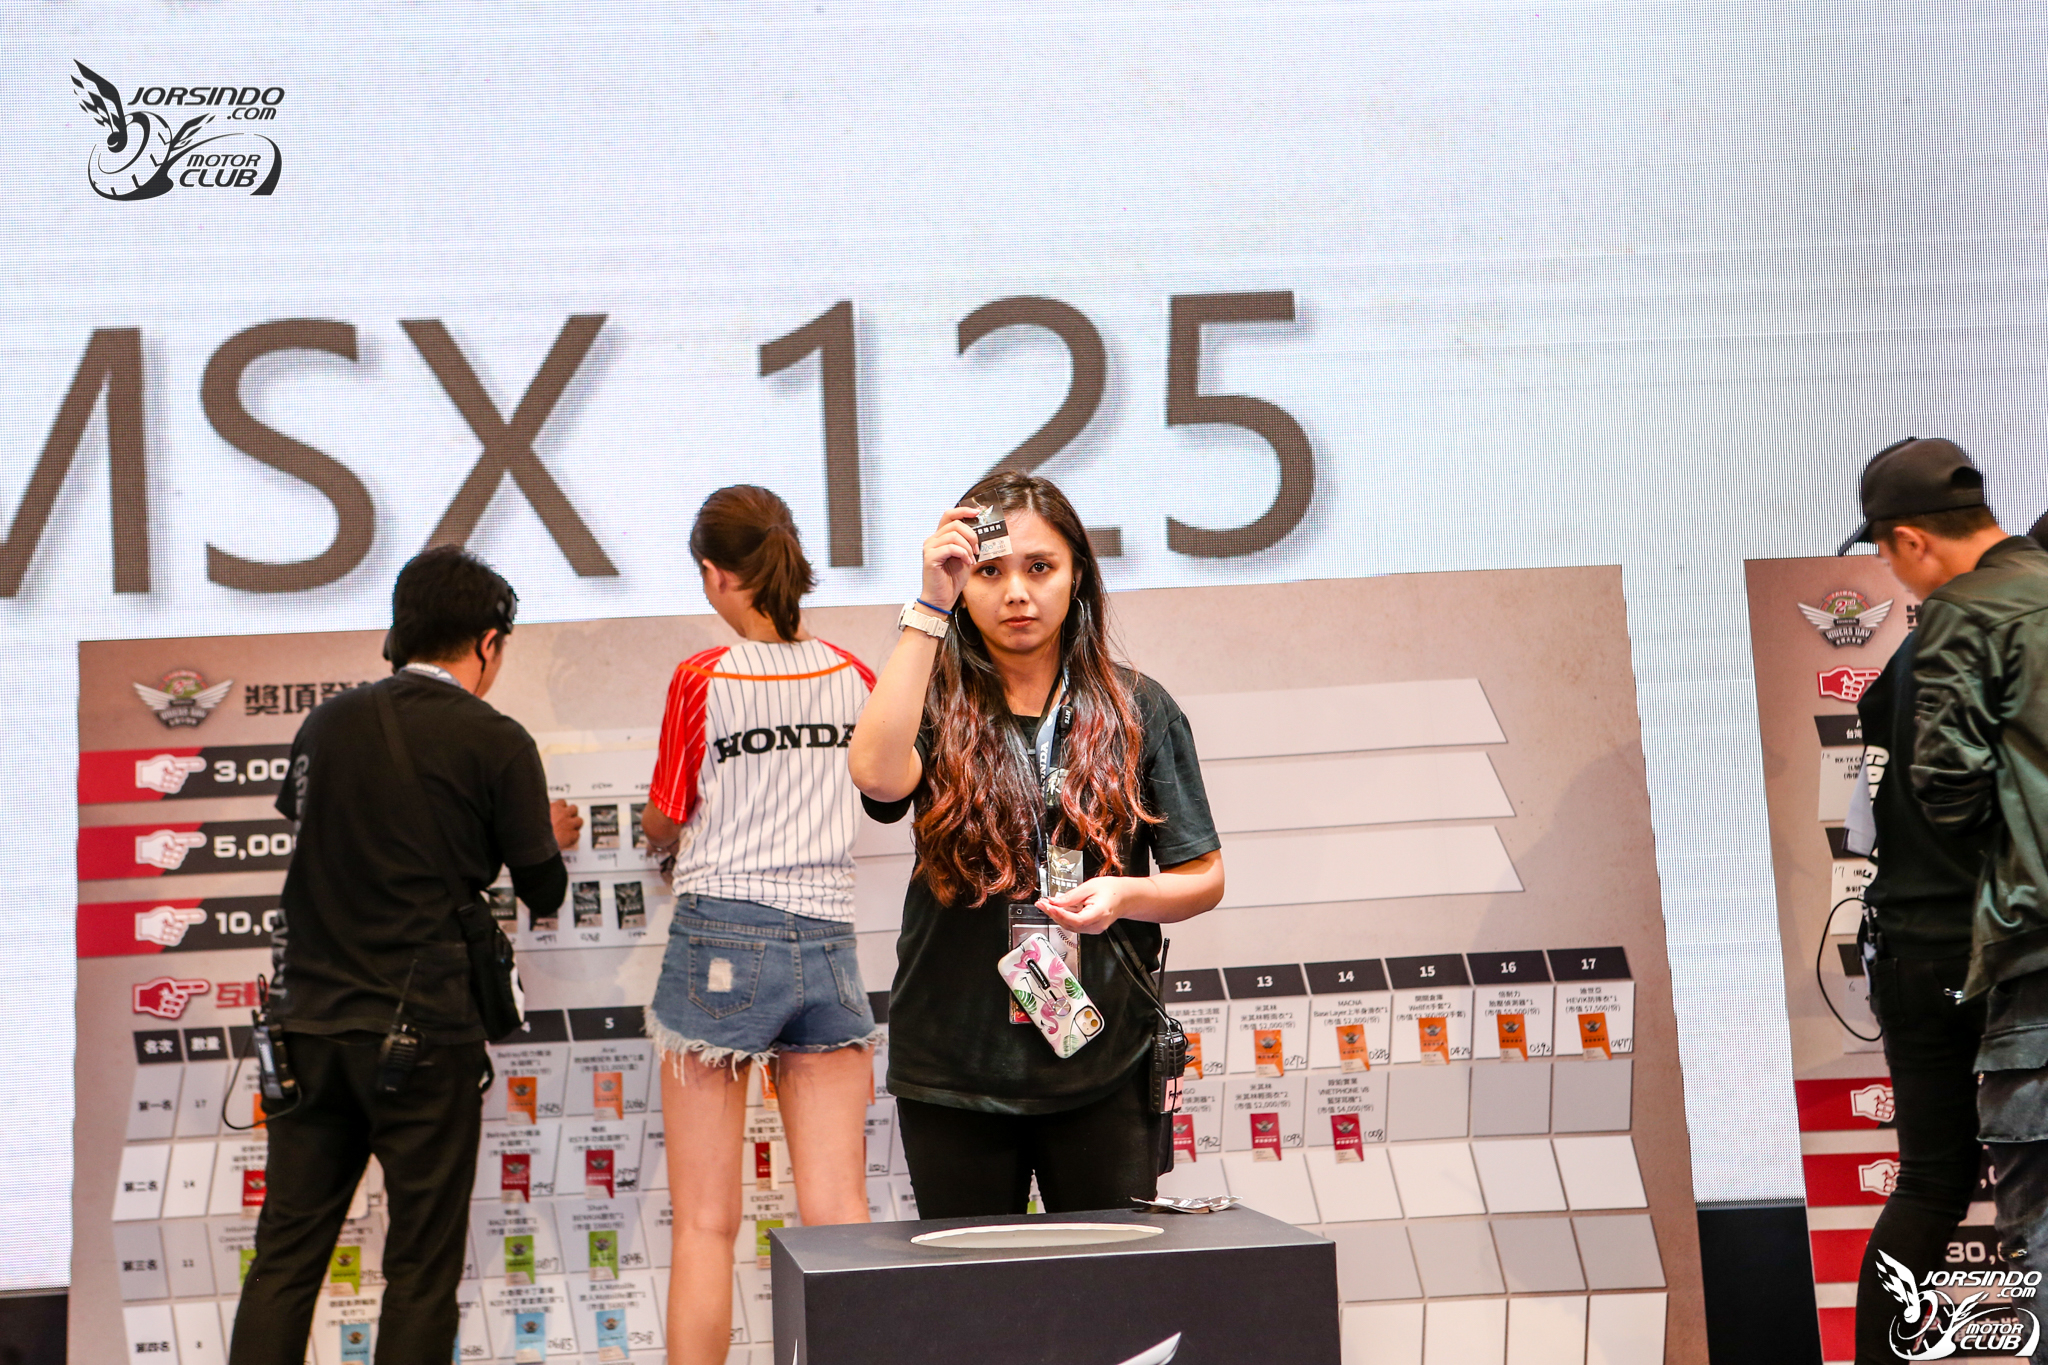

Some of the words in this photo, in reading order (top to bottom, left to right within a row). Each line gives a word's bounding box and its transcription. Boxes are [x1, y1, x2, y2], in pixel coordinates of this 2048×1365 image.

[758, 290, 1316, 568] 125
[713, 723, 857, 764] HONDA
[213, 832, 294, 861] 5,00
[1500, 961, 1517, 974] 16
[1581, 958, 1597, 970] 17
[1337, 970, 1355, 983] 14
[1419, 965, 1436, 978] 15
[1175, 980, 1193, 992] 12
[1256, 975, 1274, 988] 13
[605, 1017, 615, 1030] 5
[1944, 1241, 2003, 1265] 30,
